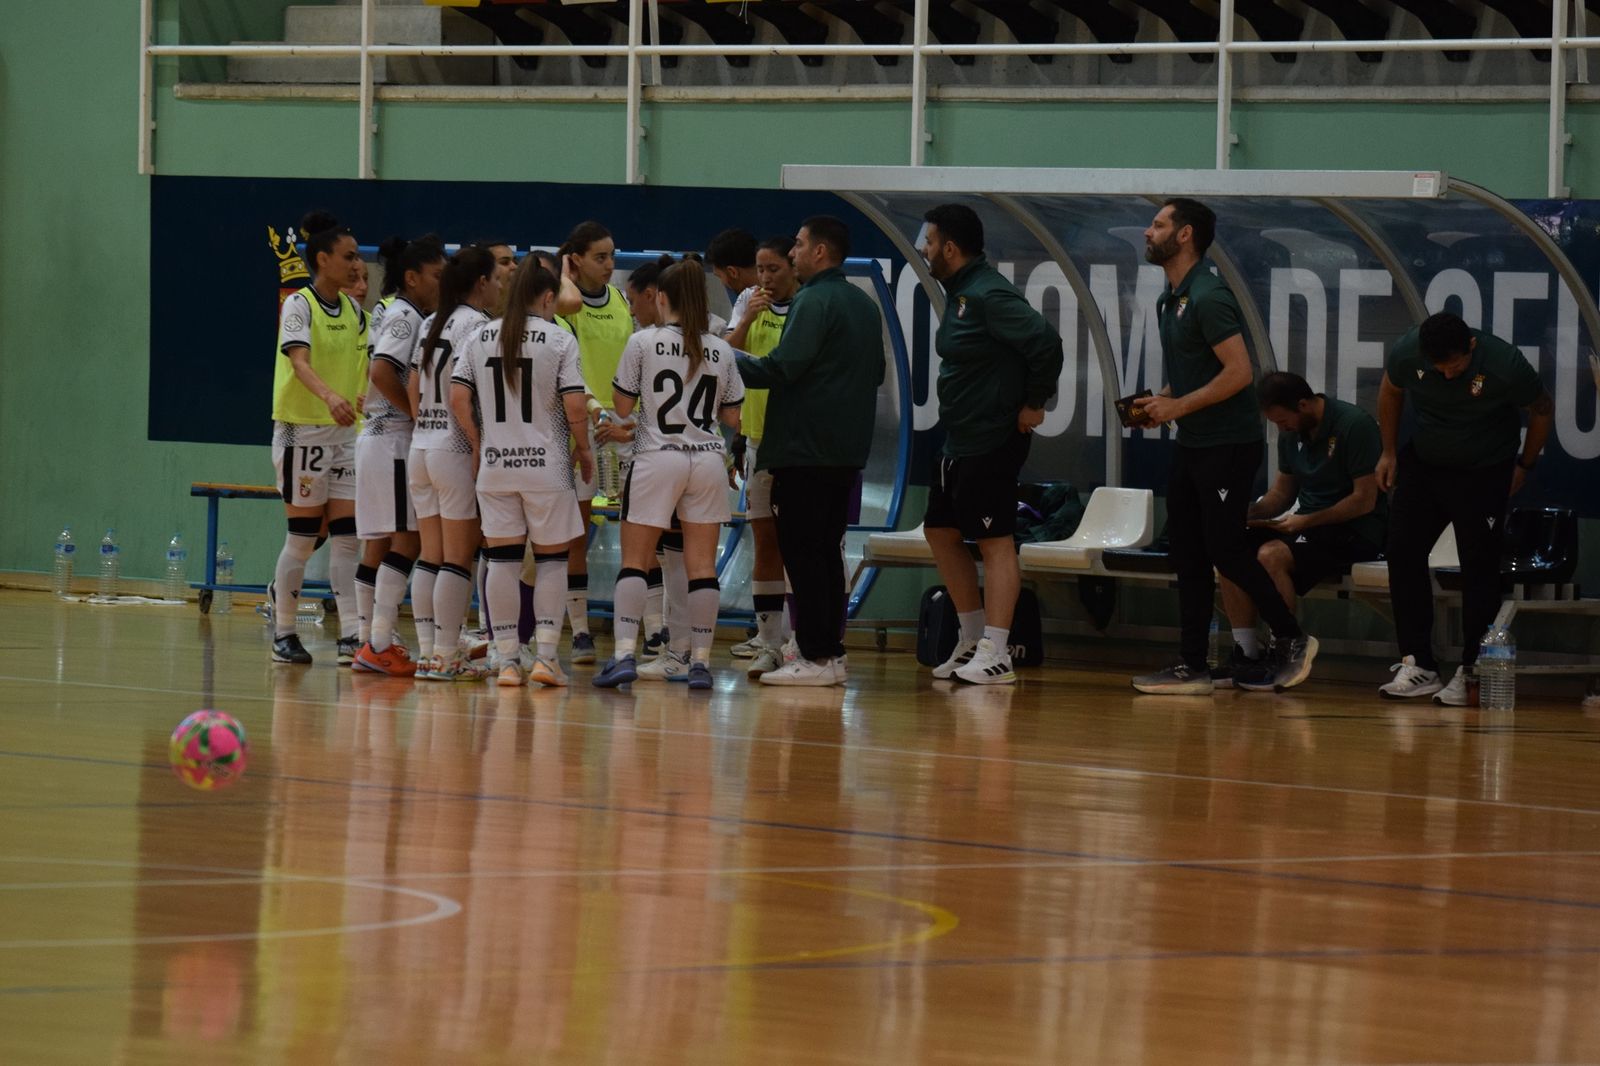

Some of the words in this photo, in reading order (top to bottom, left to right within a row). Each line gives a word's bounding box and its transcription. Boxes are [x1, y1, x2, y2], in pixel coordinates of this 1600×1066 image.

[485, 356, 533, 424] 11
[653, 368, 718, 435] 24
[299, 445, 324, 472] 12
[502, 447, 546, 457] DARYSO
[503, 458, 546, 468] MOTOR
